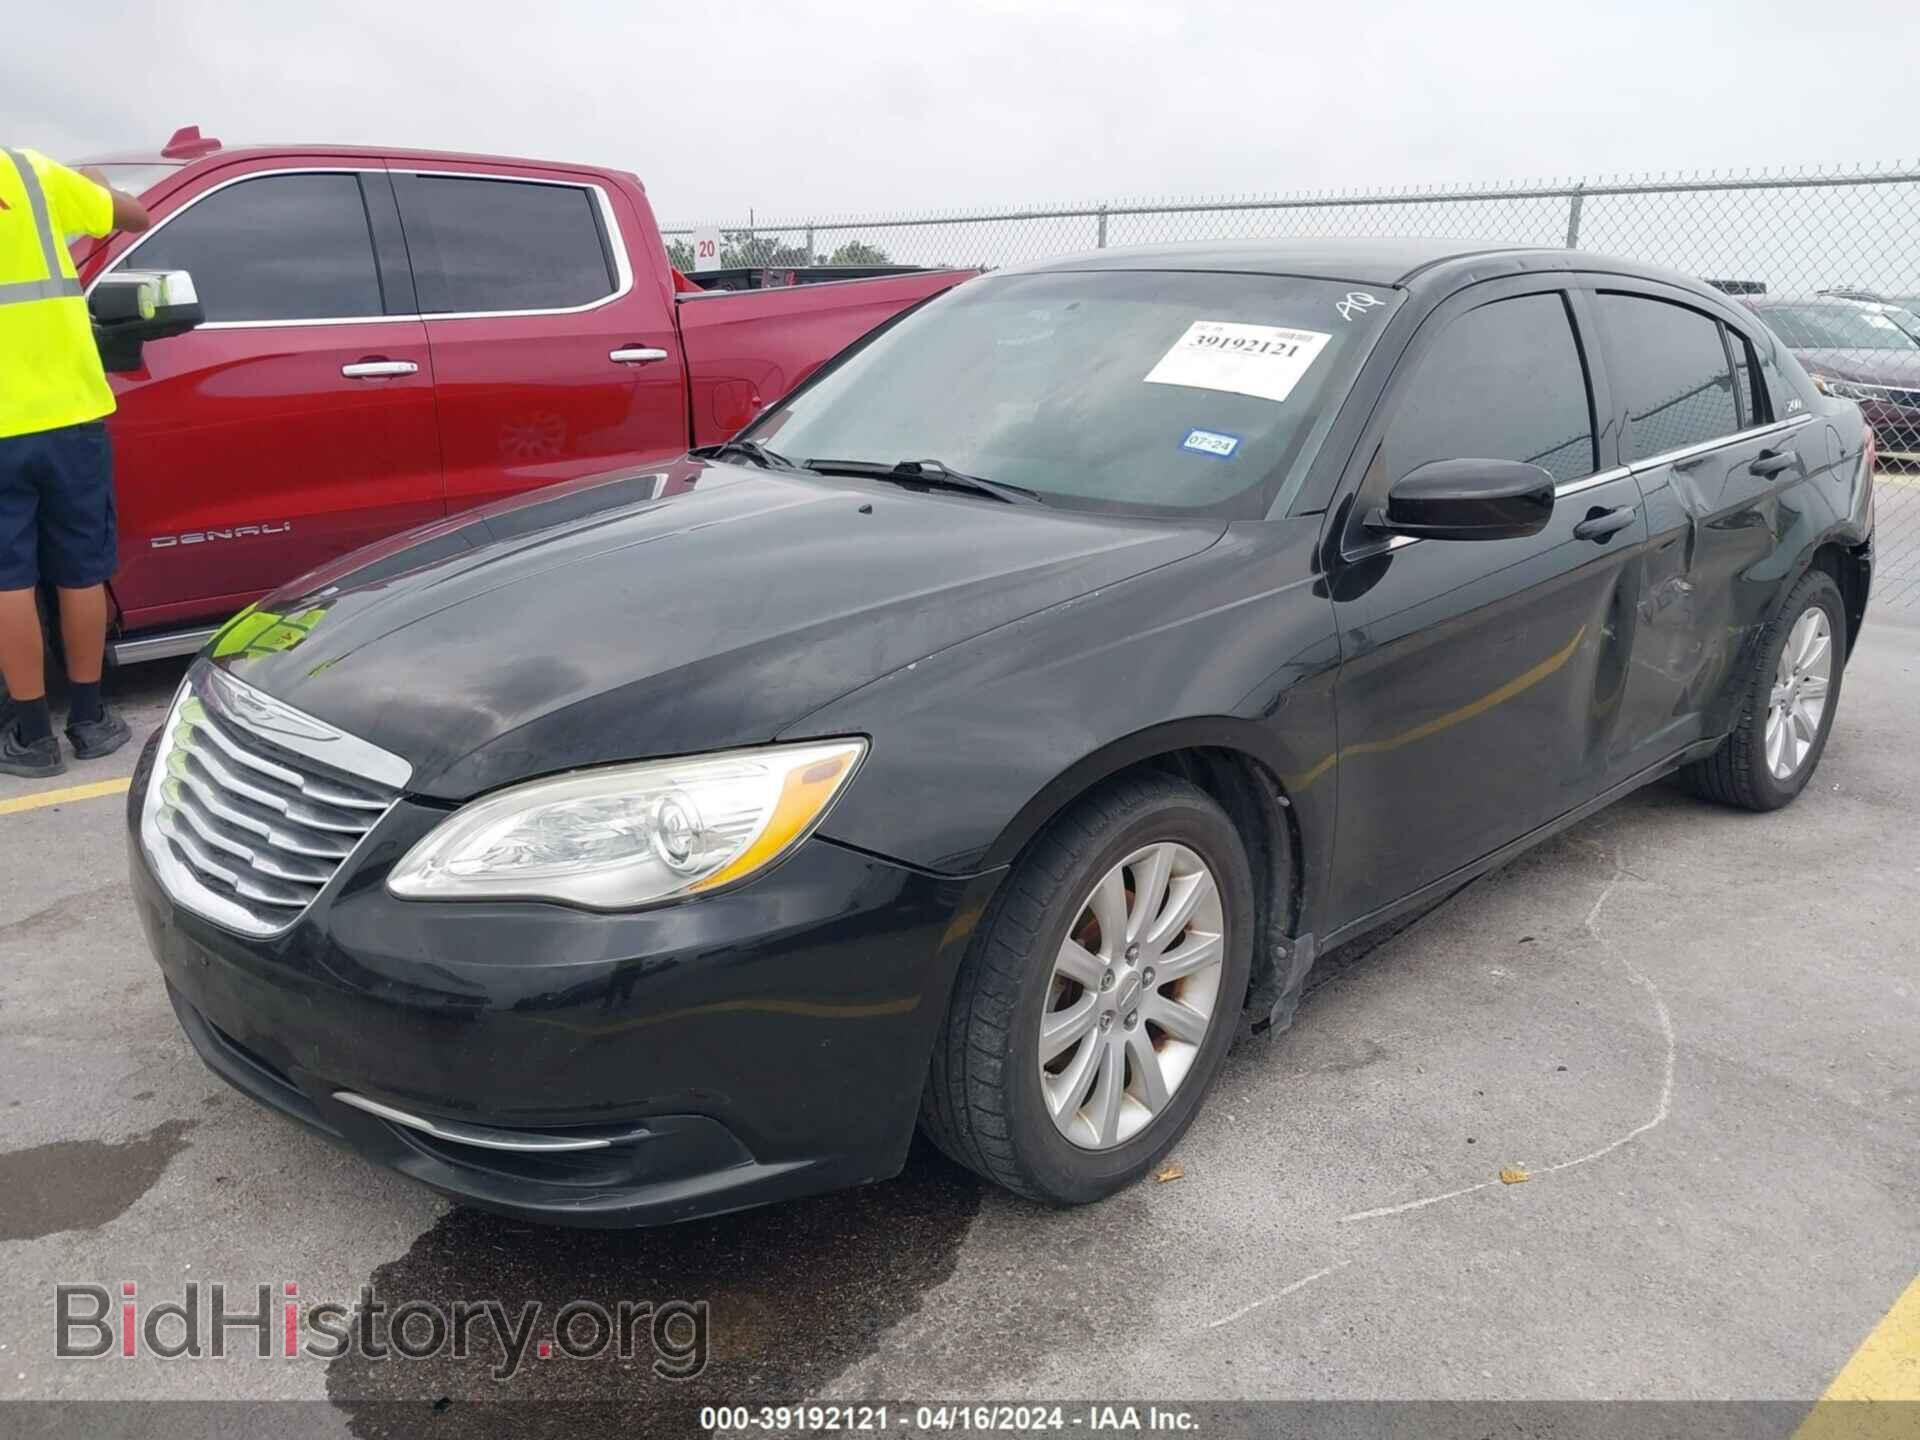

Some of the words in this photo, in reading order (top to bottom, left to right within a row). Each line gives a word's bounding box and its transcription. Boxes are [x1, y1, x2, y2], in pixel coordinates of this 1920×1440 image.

[699, 240, 715, 257] 20
[1189, 335, 1299, 357] 39192121
[150, 521, 291, 549] DENALI
